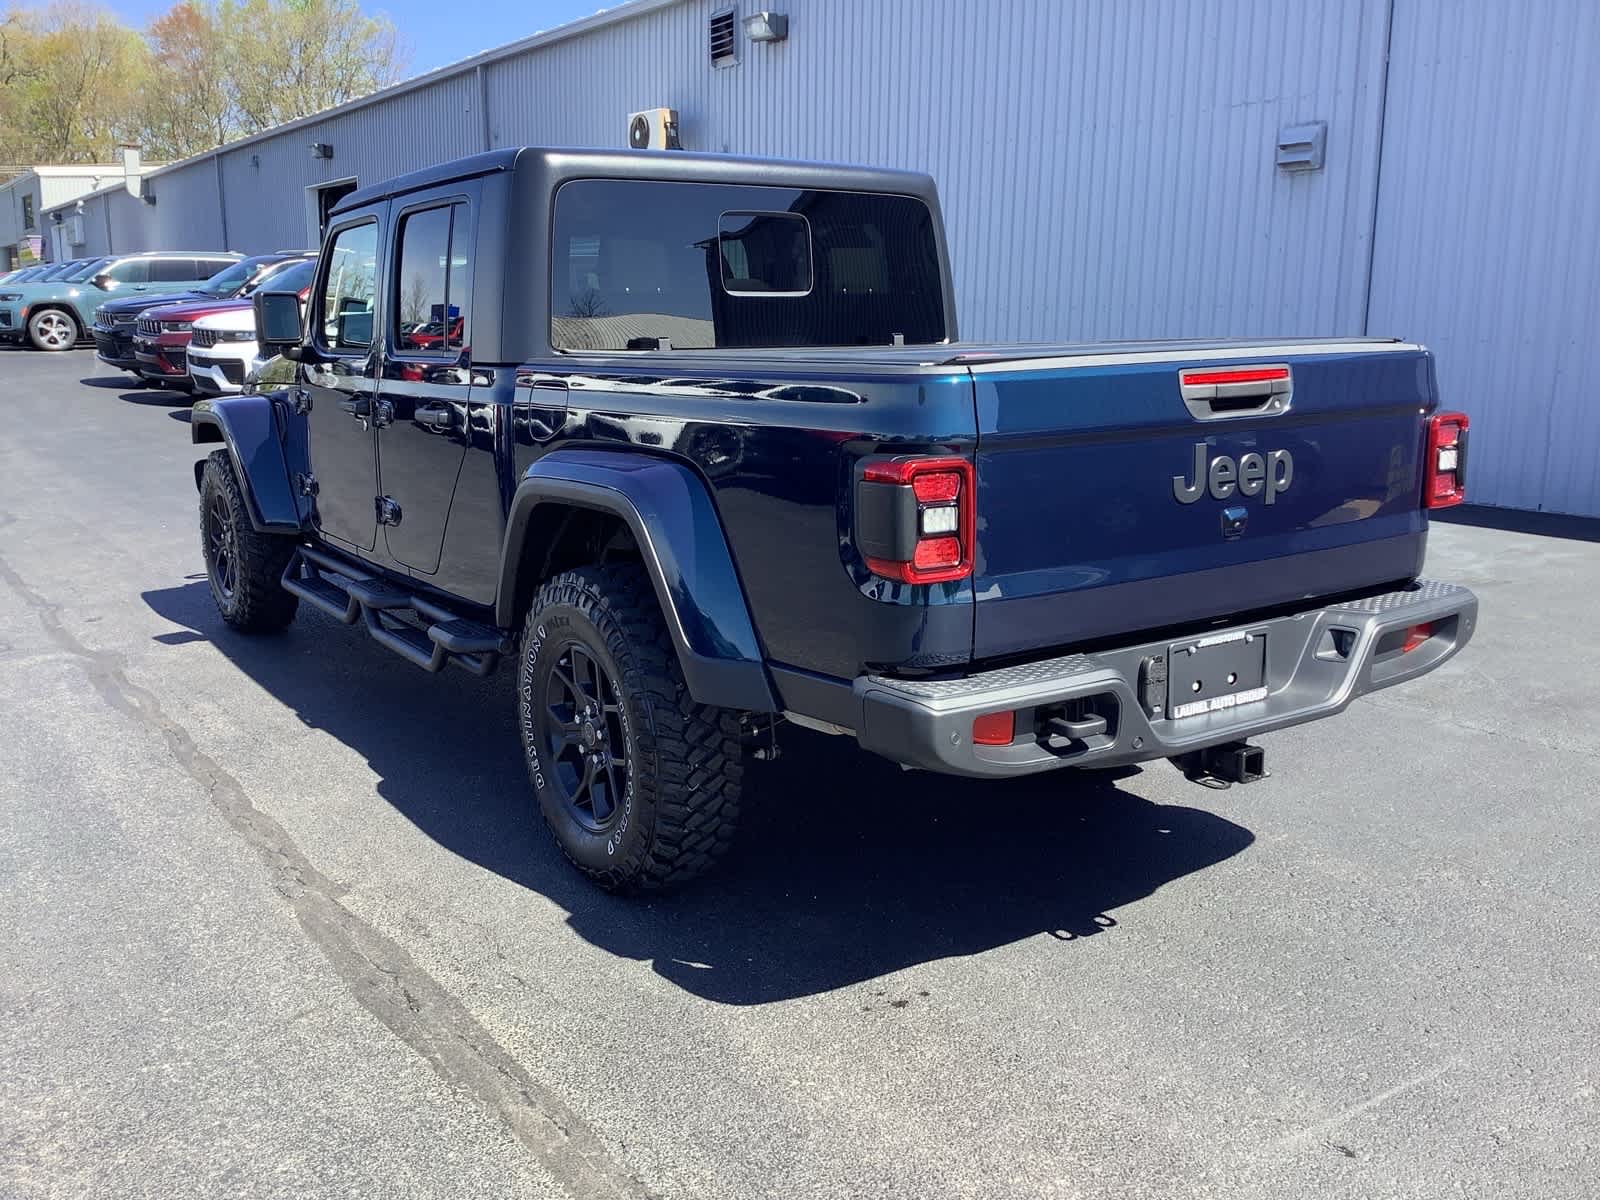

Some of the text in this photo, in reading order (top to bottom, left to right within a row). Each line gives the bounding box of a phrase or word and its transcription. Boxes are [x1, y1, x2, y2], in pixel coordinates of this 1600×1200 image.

[1173, 442, 1293, 505] Jeep
[523, 639, 545, 789] DESTINATION
[1210, 694, 1235, 711] AUTO
